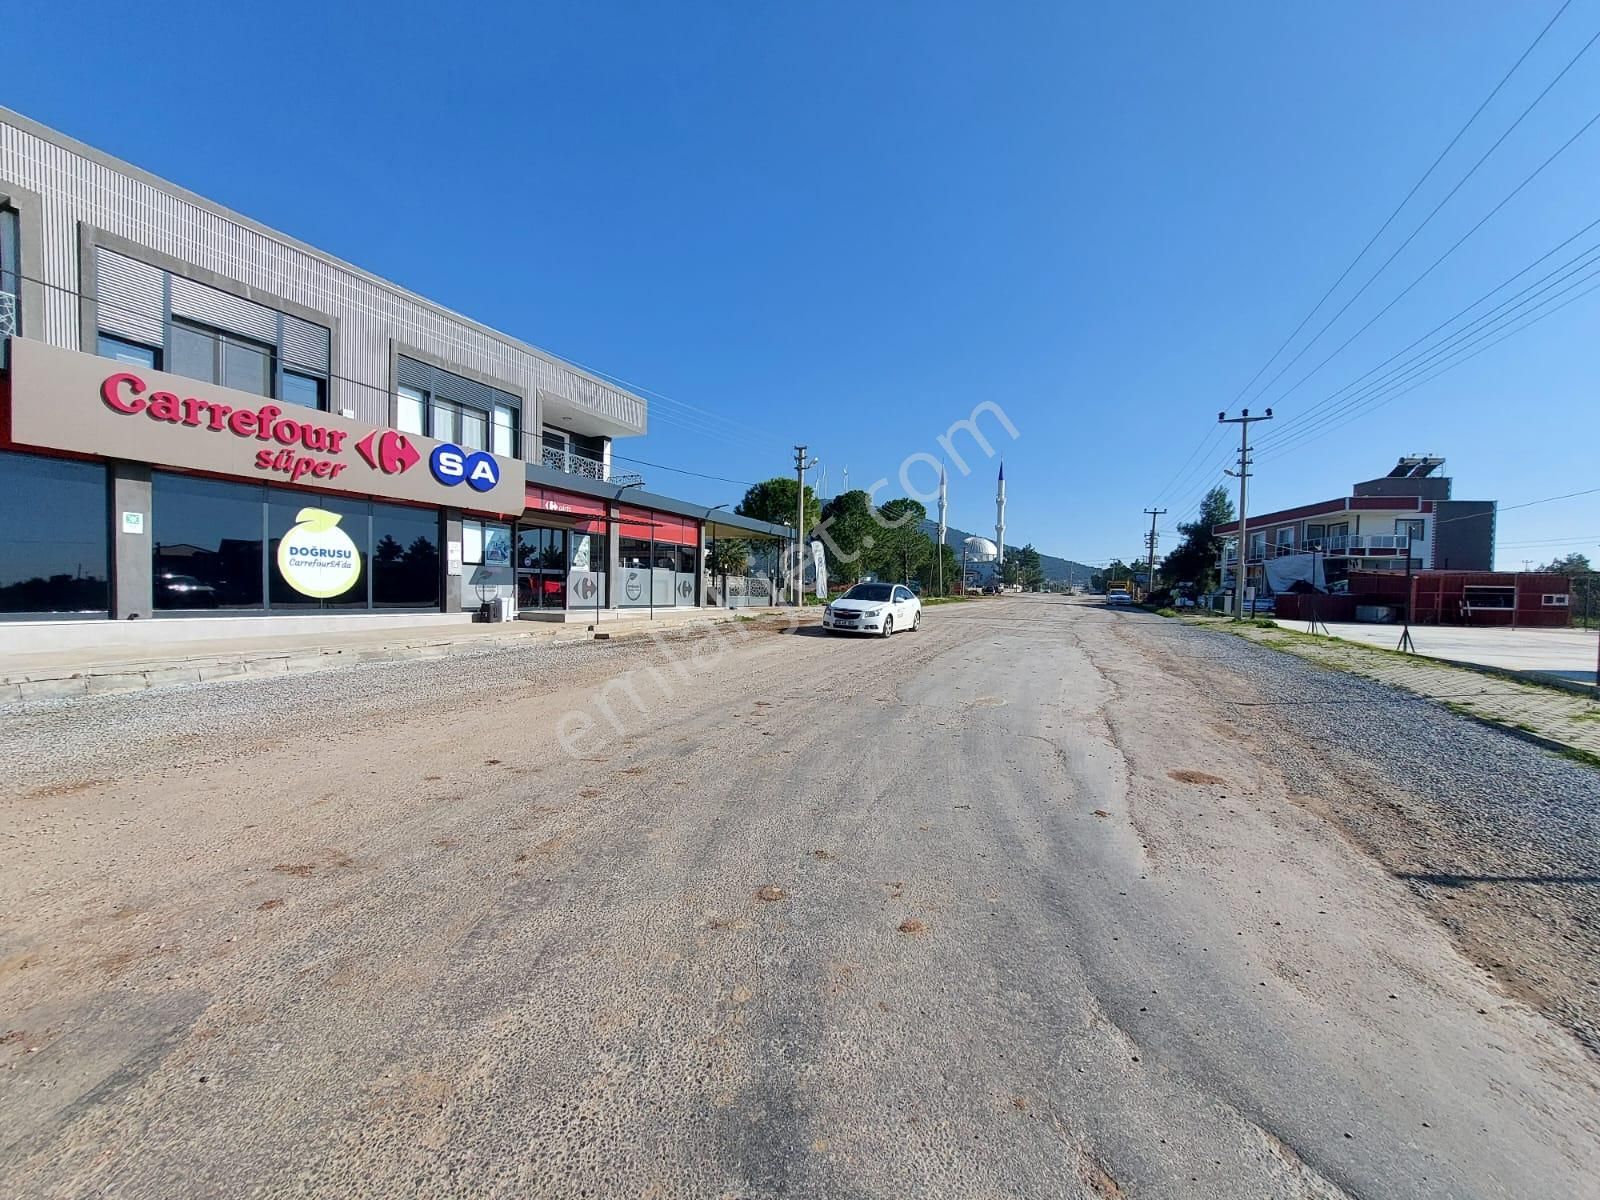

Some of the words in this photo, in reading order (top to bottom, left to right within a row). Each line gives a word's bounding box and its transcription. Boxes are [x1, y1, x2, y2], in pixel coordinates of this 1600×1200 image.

[100, 372, 347, 454] Carrefour
[439, 452, 496, 483] SA
[254, 449, 347, 481] süper
[289, 546, 352, 558] DOĞRUSU
